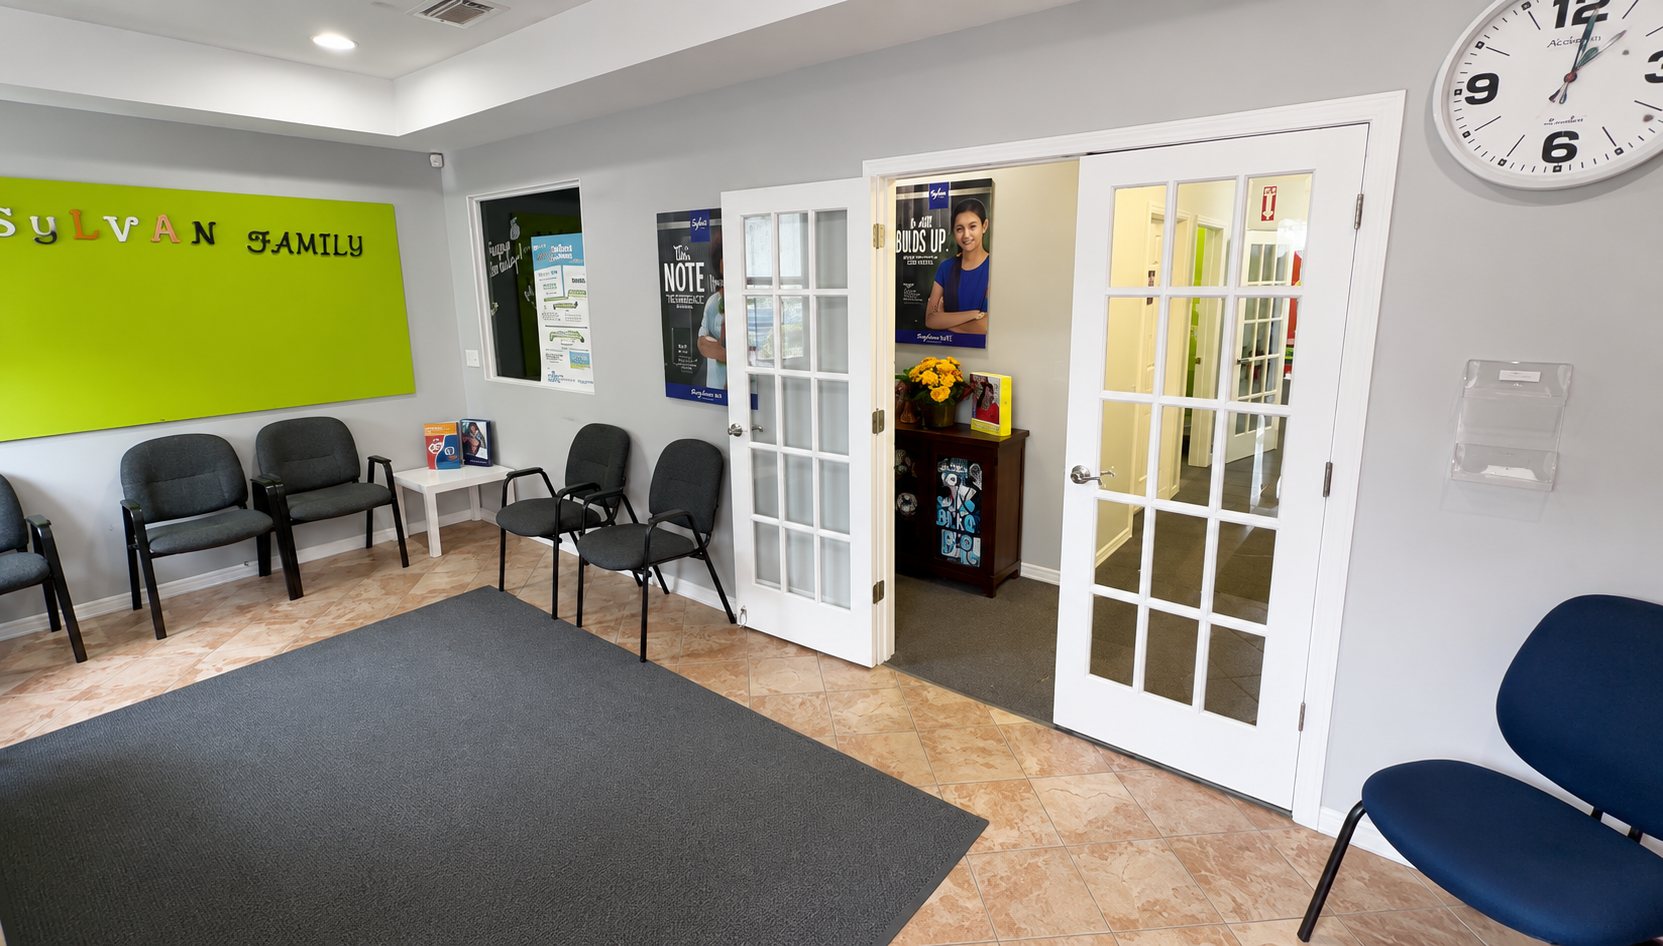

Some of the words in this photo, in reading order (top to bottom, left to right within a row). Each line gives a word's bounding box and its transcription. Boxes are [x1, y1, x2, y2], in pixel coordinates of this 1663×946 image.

[1552, 0, 1612, 29] 12
[1644, 50, 1663, 84] 3
[1464, 72, 1500, 106] 9
[1541, 130, 1580, 164] 6
[246, 229, 364, 258] FAMILY
[663, 261, 705, 293] NOTE
